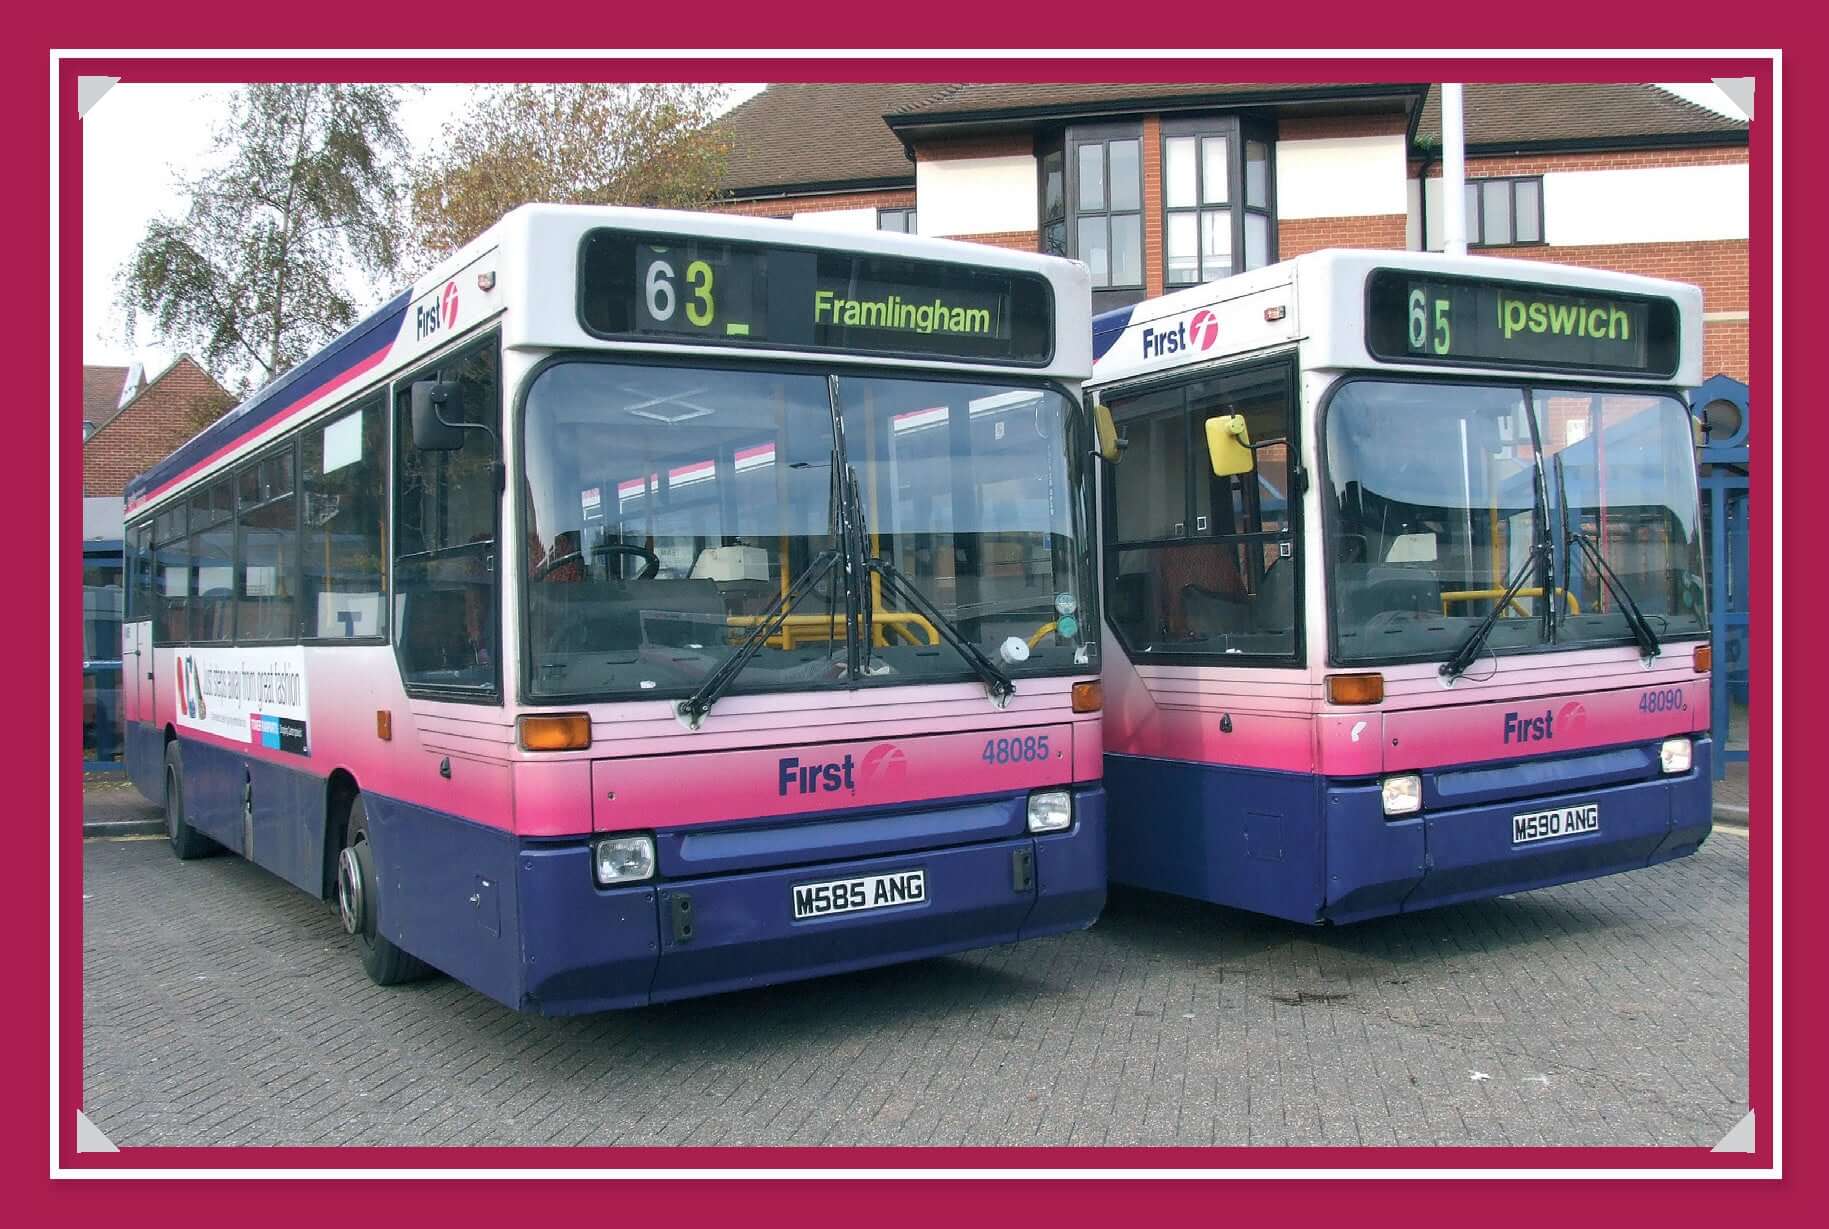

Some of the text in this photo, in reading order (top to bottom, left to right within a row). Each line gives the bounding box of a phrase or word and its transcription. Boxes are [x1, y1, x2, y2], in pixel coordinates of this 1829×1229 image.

[416, 295, 440, 342] First
[815, 290, 990, 334] Framlingham
[1409, 289, 1450, 355] 65
[1497, 291, 1629, 340] Ipswich
[1143, 320, 1186, 359] First
[1640, 688, 1682, 713] 48090
[1504, 710, 1553, 744] First
[983, 735, 1049, 765] 48085
[778, 754, 855, 796] First
[1515, 806, 1597, 842] M590 ANG
[796, 874, 923, 916] M585 ANG
